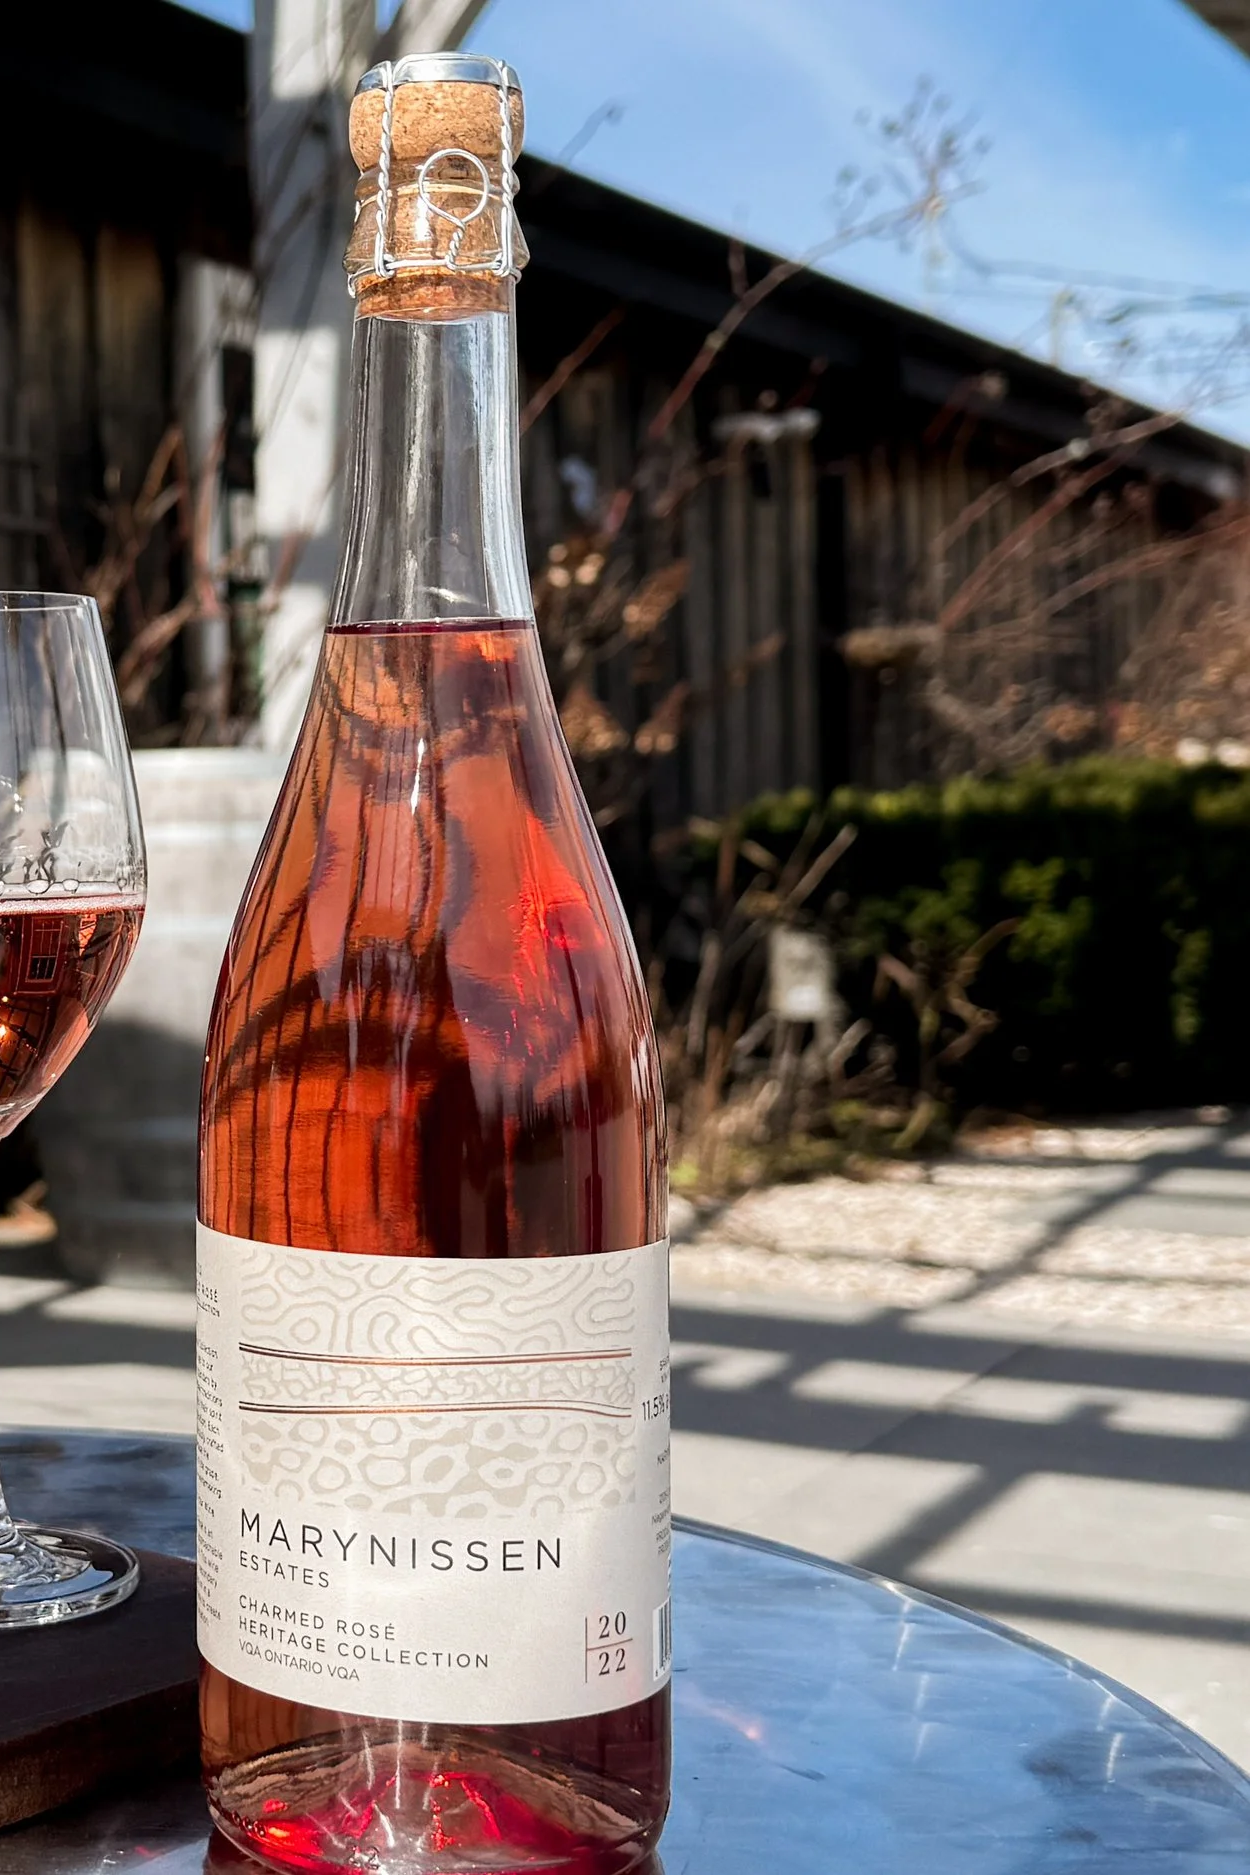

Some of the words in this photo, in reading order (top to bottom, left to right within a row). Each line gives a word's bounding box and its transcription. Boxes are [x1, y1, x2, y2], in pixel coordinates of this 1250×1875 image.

[241, 1507, 561, 1572] MARYNISSEN
[239, 1549, 330, 1589] ESTATES
[238, 1594, 325, 1630] CHARMED
[336, 1618, 396, 1641] ROSÉ
[598, 1610, 627, 1640] 20
[238, 1638, 262, 1659] VQA
[264, 1648, 323, 1675] ONTARIO
[326, 1663, 360, 1682] VQA
[239, 1615, 326, 1654] HERITAGE
[337, 1642, 488, 1669] COLLECTION
[598, 1647, 627, 1677] 22
